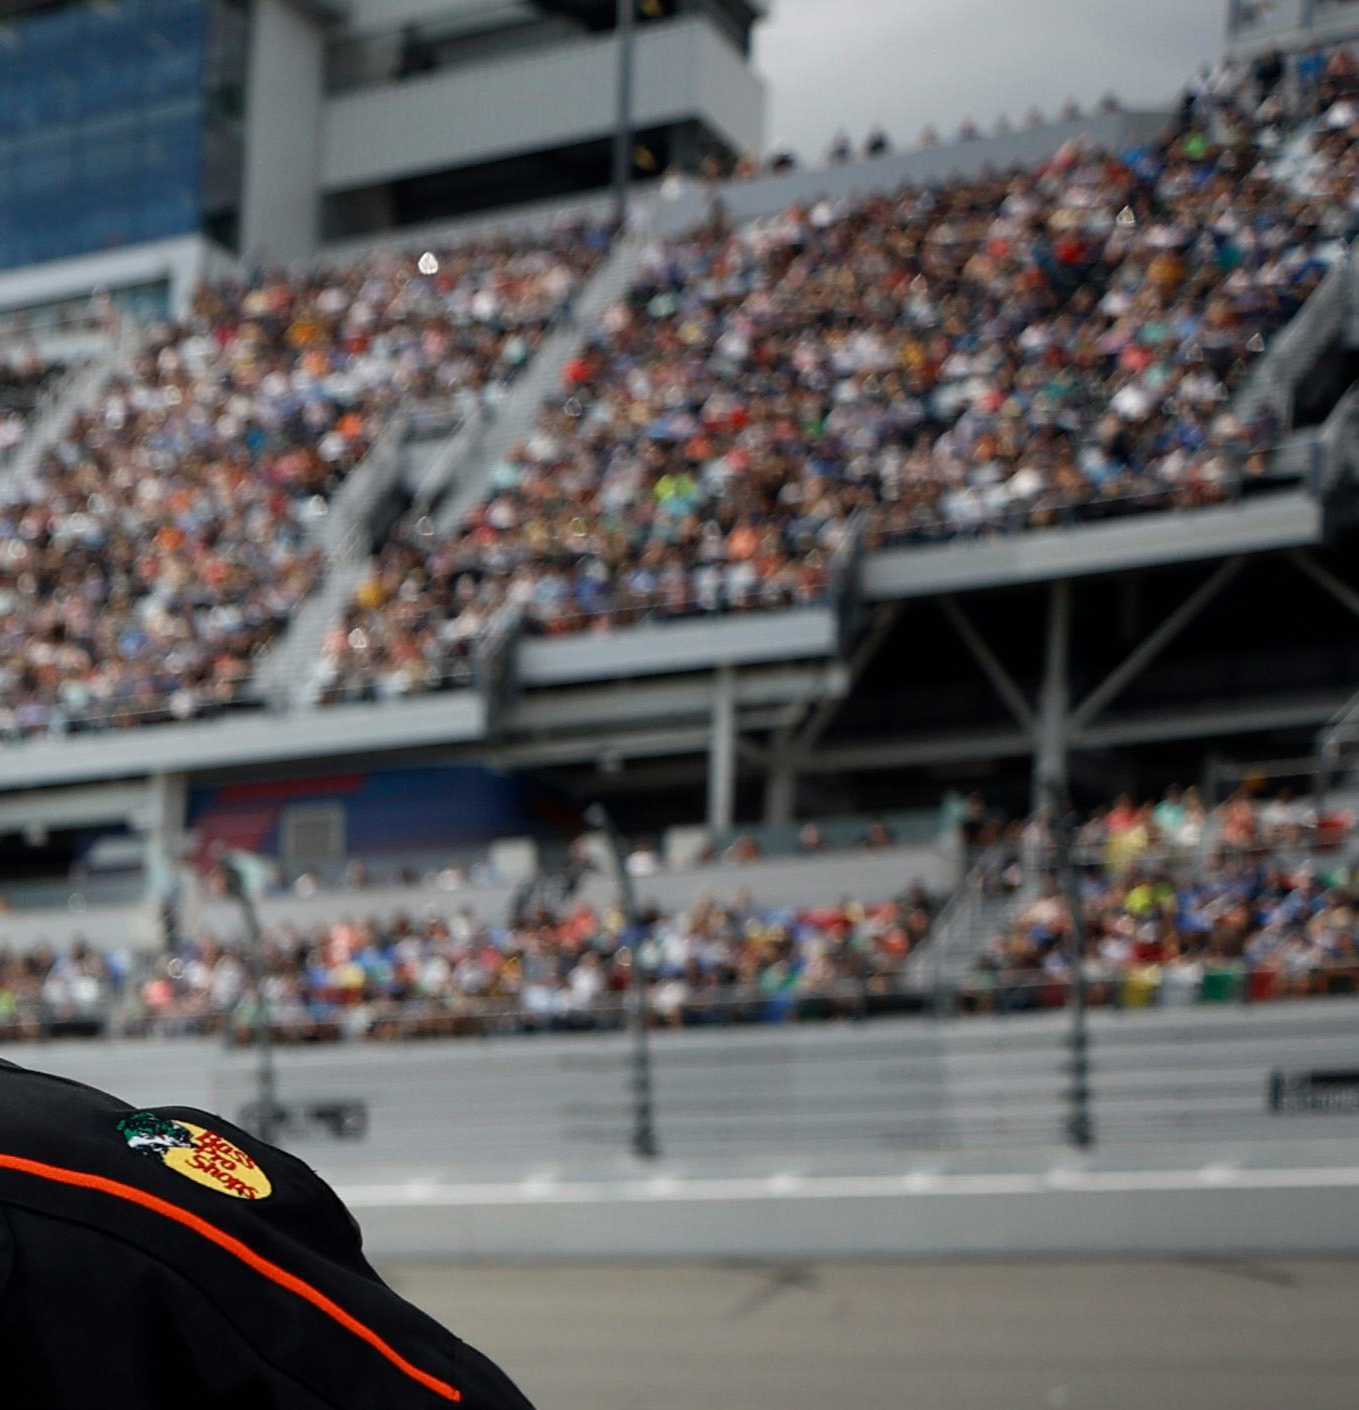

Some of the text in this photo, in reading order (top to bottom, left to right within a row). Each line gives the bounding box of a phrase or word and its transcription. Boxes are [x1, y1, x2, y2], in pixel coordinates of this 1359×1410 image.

[193, 1144, 237, 1171] Pro
[195, 1130, 256, 1170] Bass
[185, 1154, 259, 1200] Shops
